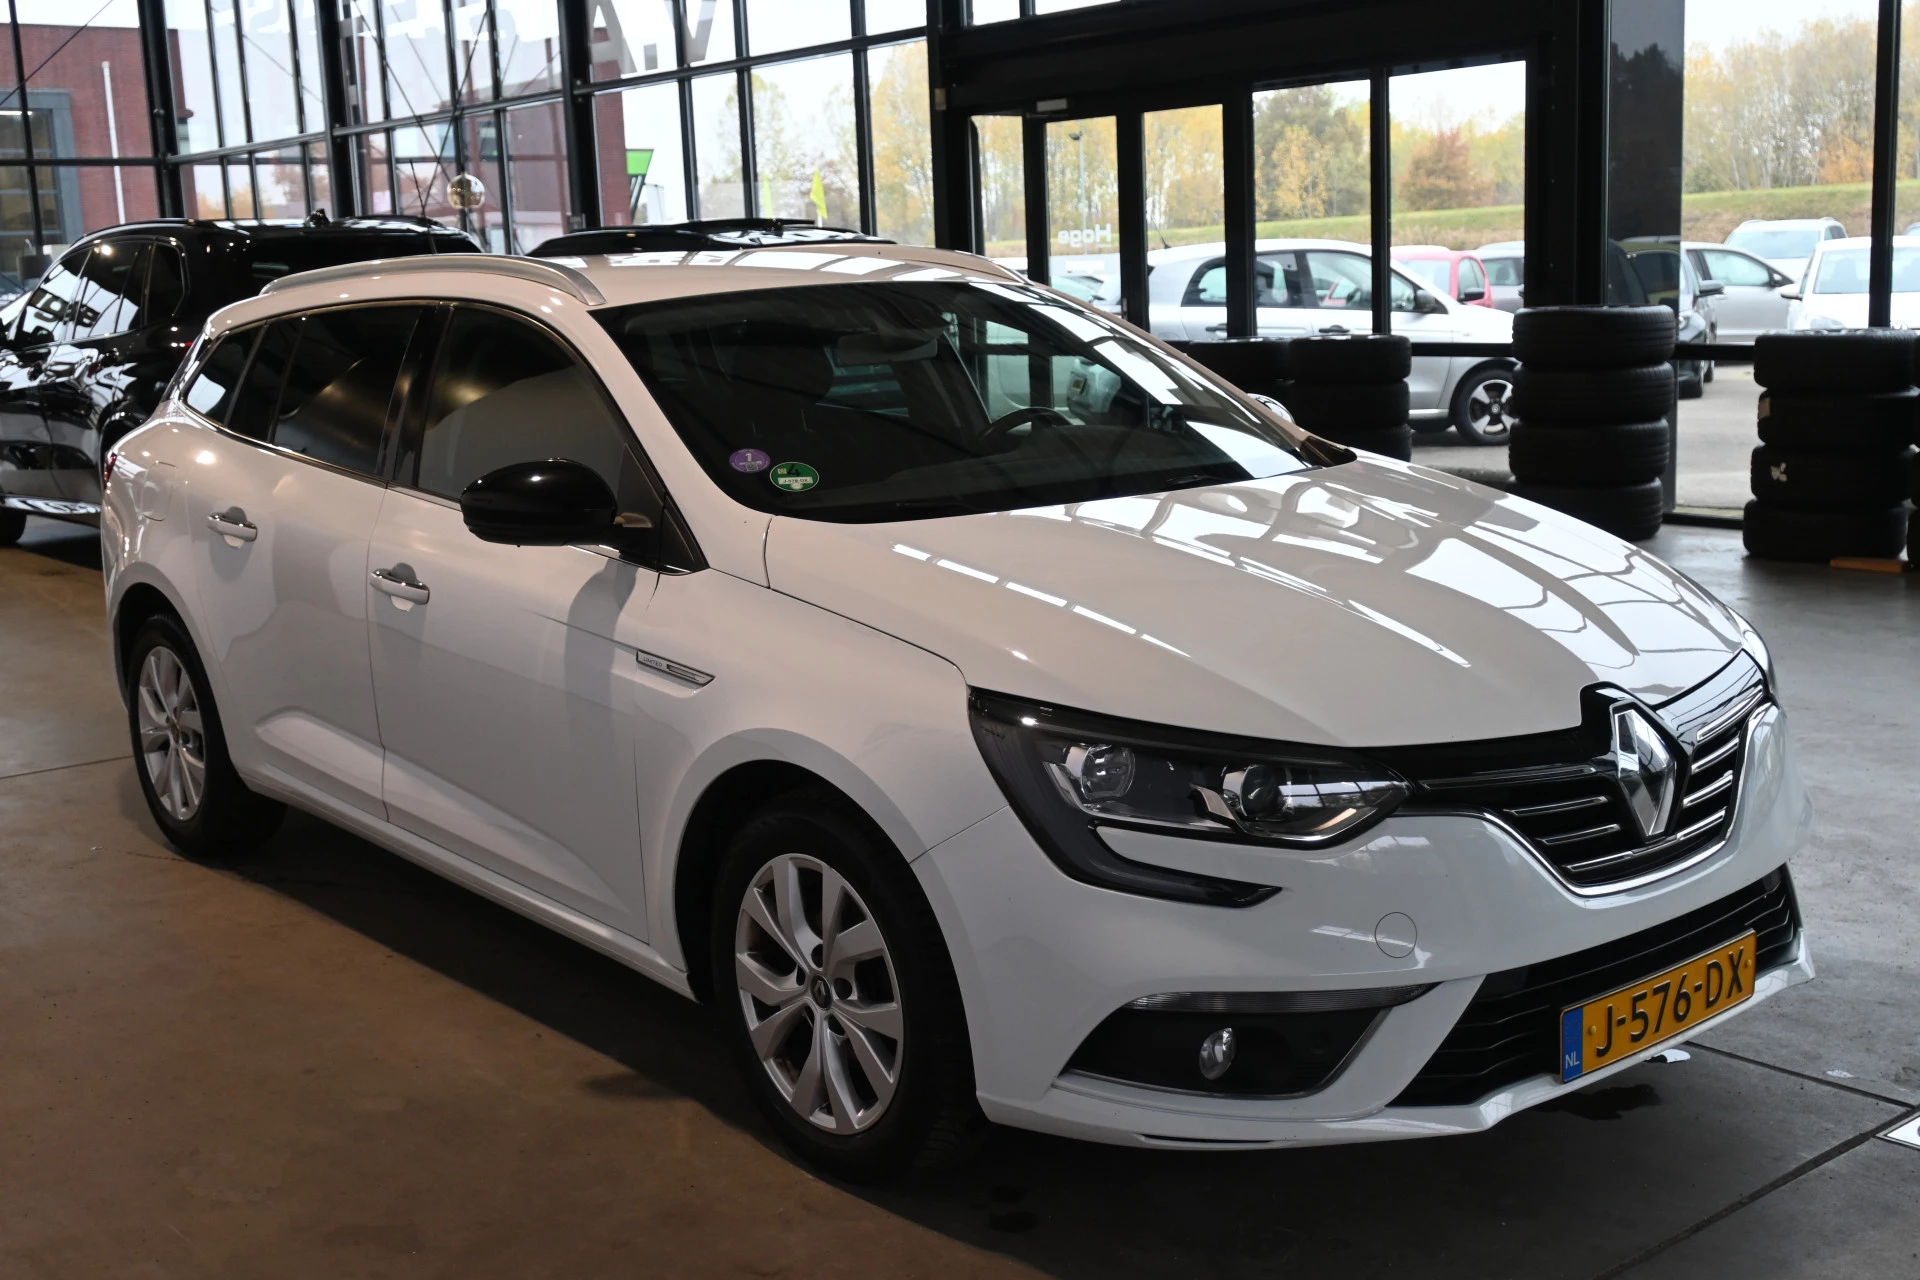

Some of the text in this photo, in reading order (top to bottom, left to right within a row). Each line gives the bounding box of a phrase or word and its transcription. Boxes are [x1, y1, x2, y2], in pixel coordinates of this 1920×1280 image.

[643, 656, 663, 668] LIMITED
[1595, 946, 1745, 1058] J-576-DX
[1565, 1052, 1580, 1069] NL
